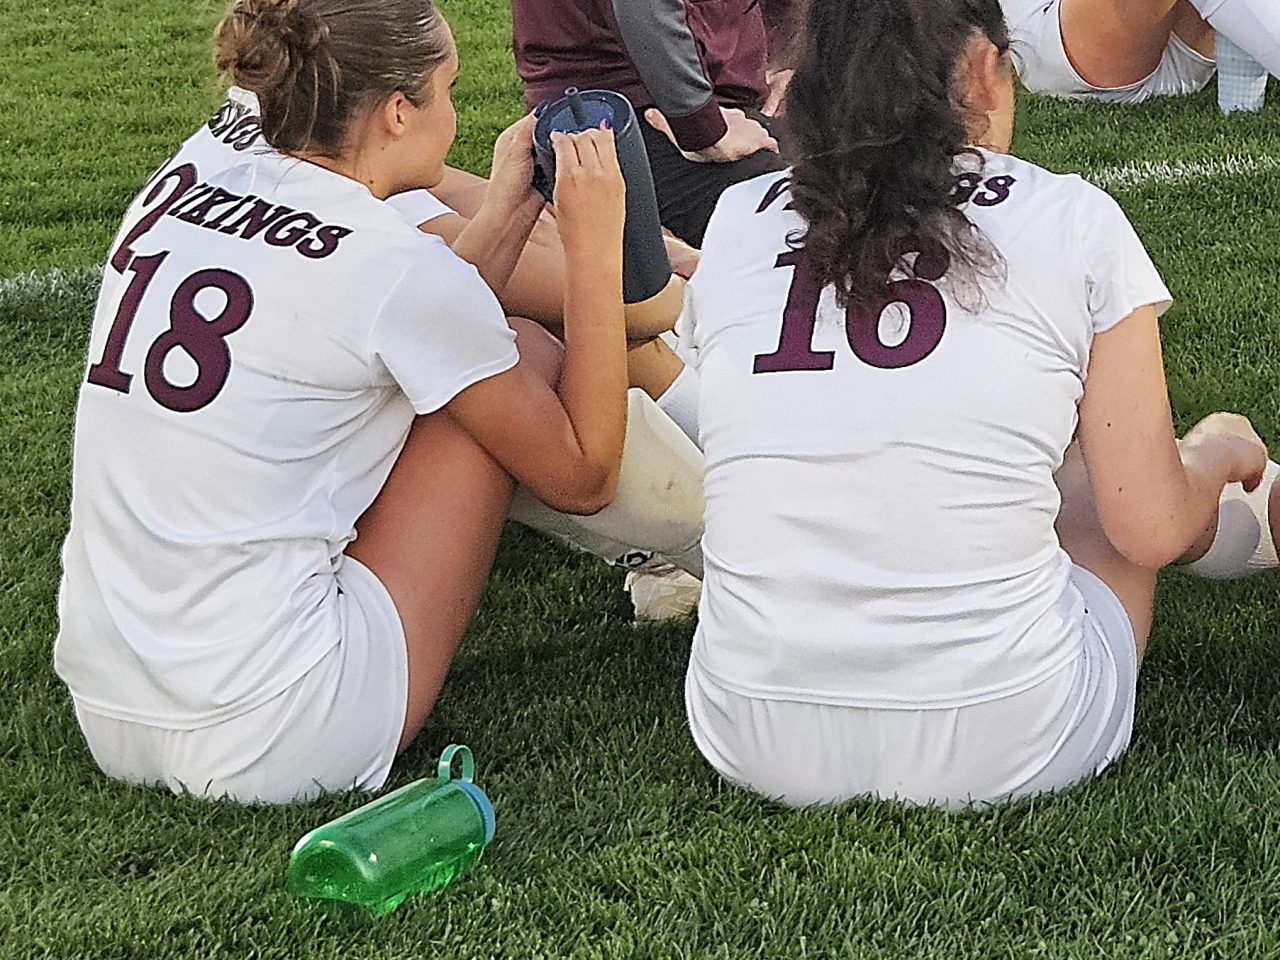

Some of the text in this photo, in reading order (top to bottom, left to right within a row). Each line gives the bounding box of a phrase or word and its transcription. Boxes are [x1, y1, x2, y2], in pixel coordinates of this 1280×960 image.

[167, 182, 354, 259] IKINGS
[87, 250, 255, 413] 18
[752, 237, 948, 374] 16
